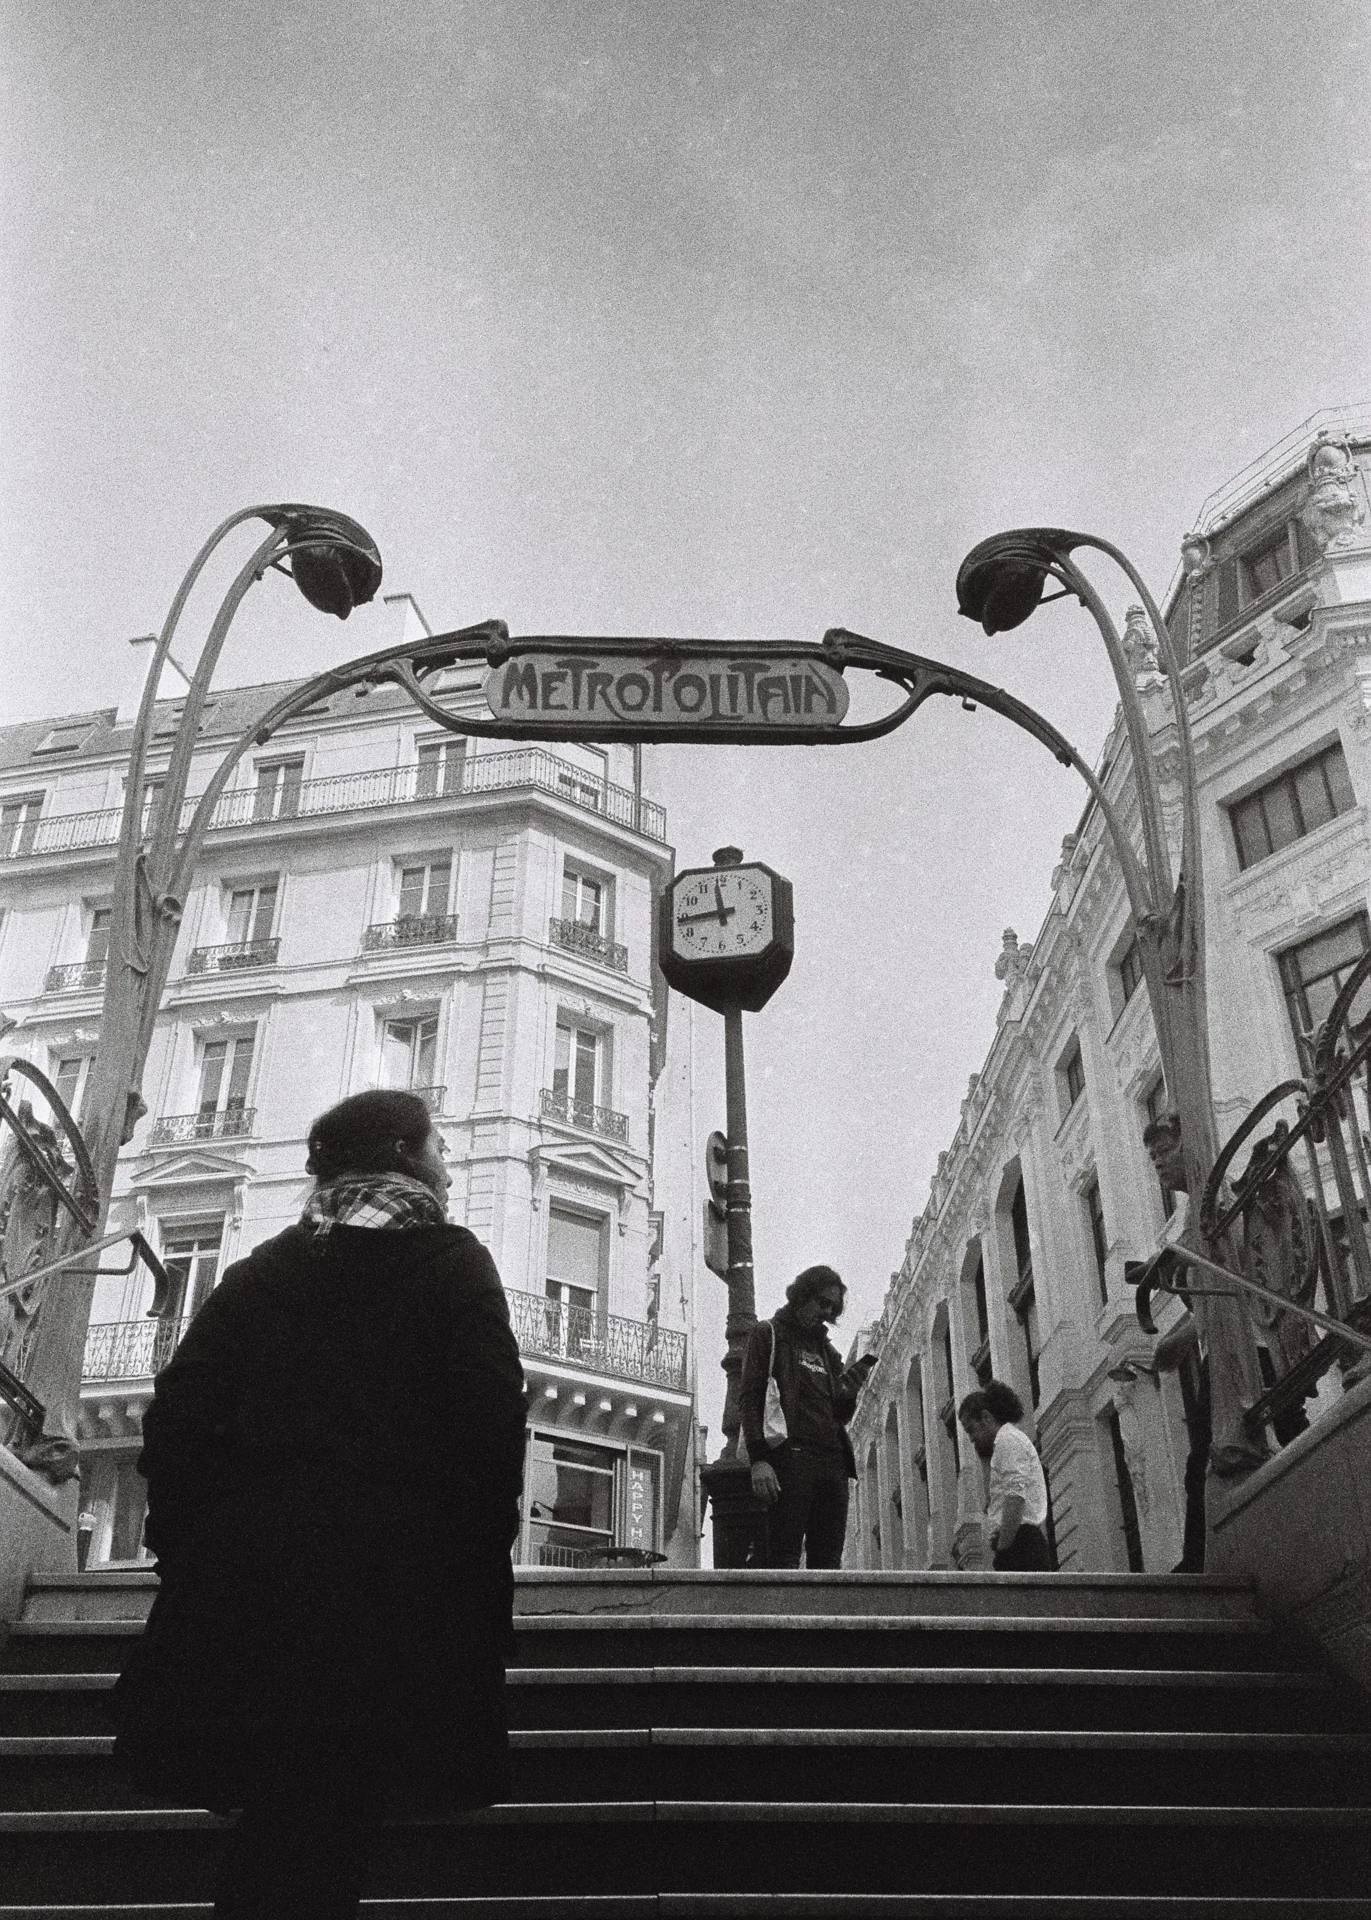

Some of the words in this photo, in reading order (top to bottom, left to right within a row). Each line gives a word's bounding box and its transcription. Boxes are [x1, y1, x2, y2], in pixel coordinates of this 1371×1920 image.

[500, 658, 837, 721] METROPOLITAIN
[699, 884, 708, 894] 11
[750, 890, 758, 900] 2
[686, 896, 698, 907] 10
[756, 905, 764, 915] 3
[750, 921, 760, 931] 4
[686, 928, 695, 938] 8
[701, 937, 708, 947] 7
[737, 934, 744, 945] 5
[719, 941, 726, 951] 6
[632, 1470, 644, 1523] HAPPY
